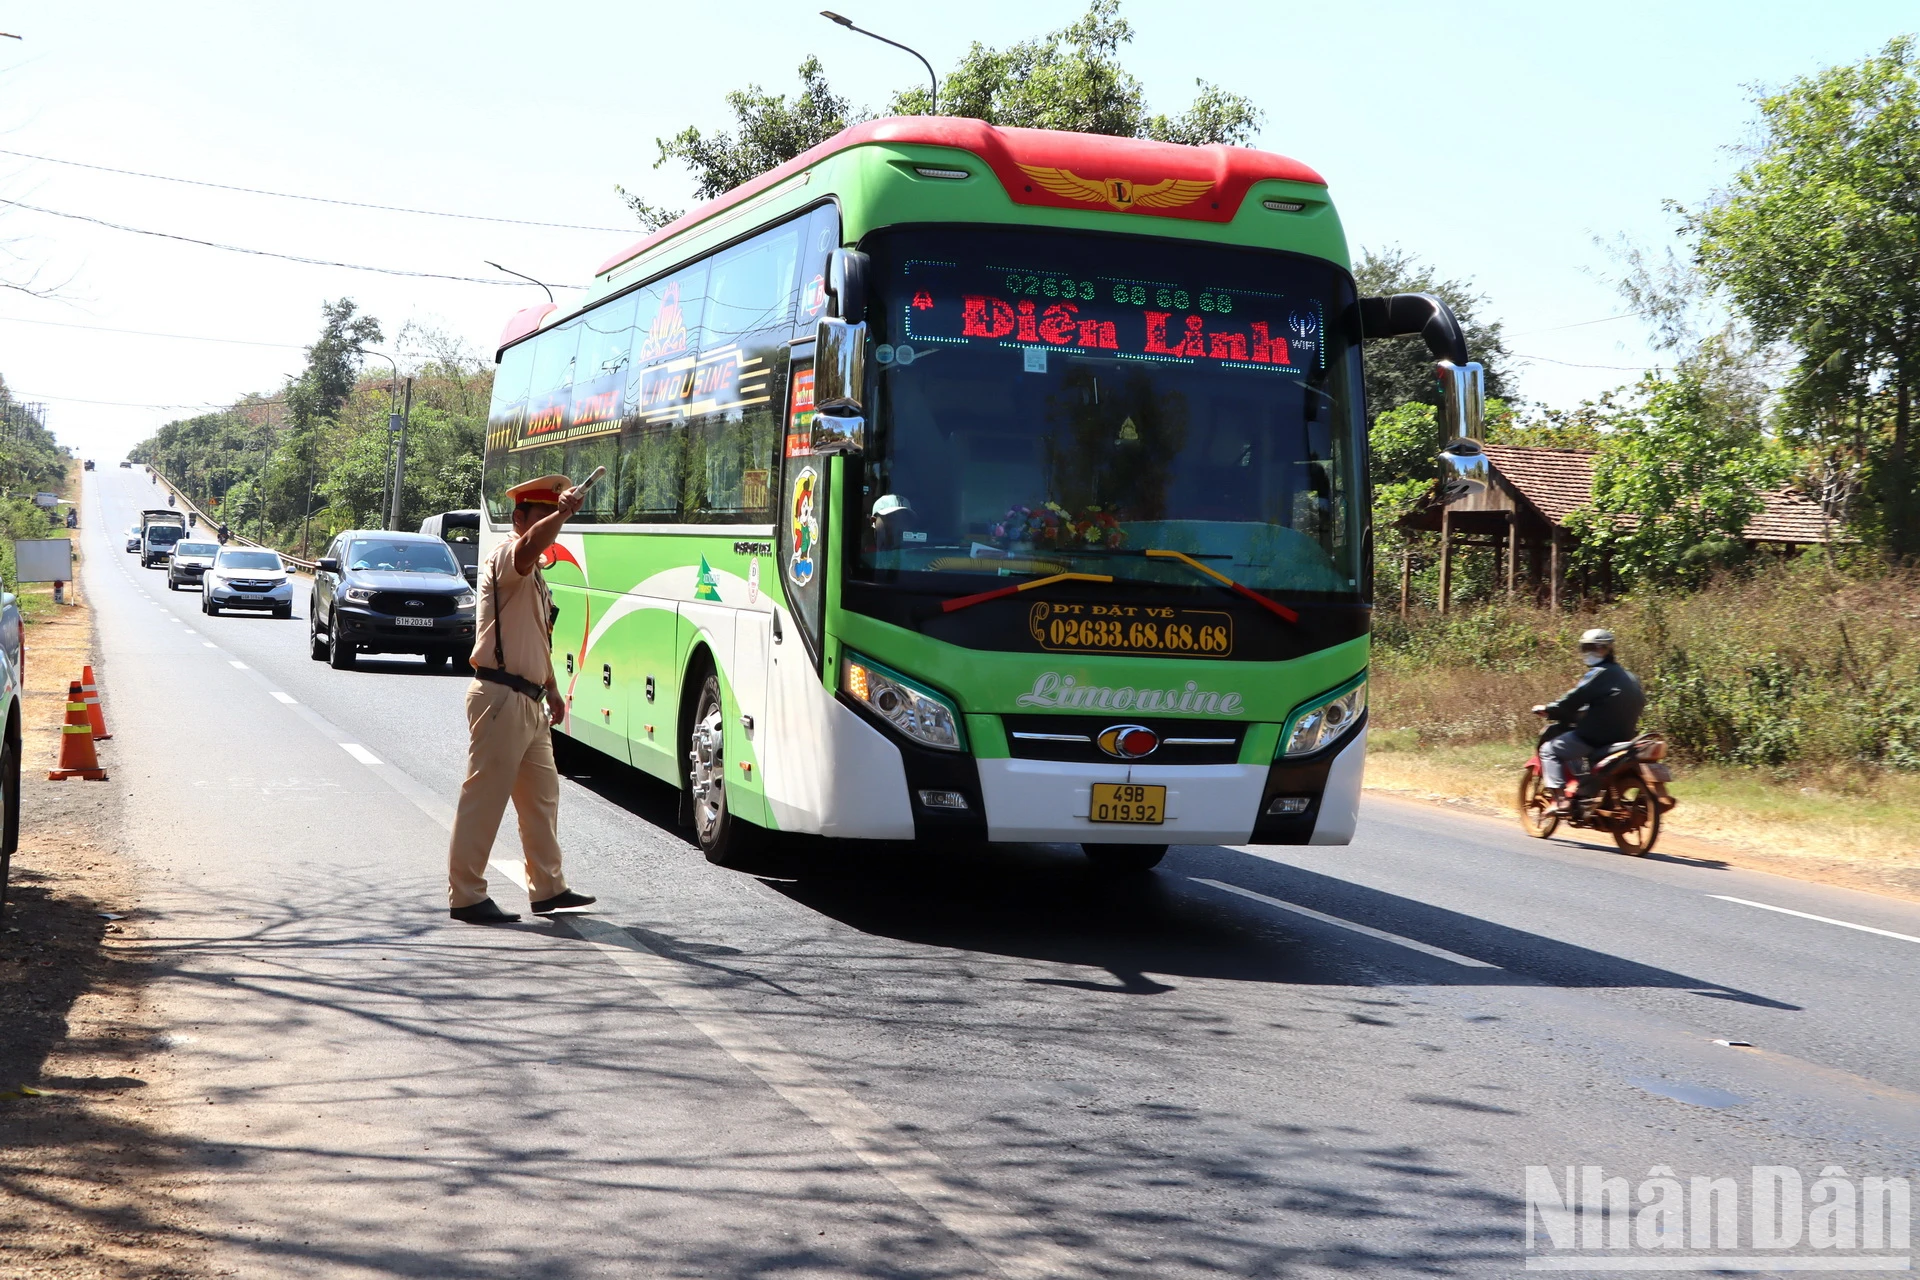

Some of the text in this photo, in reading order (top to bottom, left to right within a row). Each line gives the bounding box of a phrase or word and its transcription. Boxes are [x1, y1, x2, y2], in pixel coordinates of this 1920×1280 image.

[1006, 274, 1232, 313] 02633 68 68 68
[1144, 311, 1290, 365] Linh
[1292, 339, 1315, 350] WIFI
[642, 360, 736, 406] LIMOUSINE
[573, 390, 619, 426] LINH
[1053, 604, 1175, 618] ĐT ĐẶT VÉ
[1050, 618, 1228, 651] 02633.68.68.68
[1016, 671, 1244, 714] Limousine
[1113, 786, 1145, 802] 49B
[1098, 803, 1156, 821] 019.92
